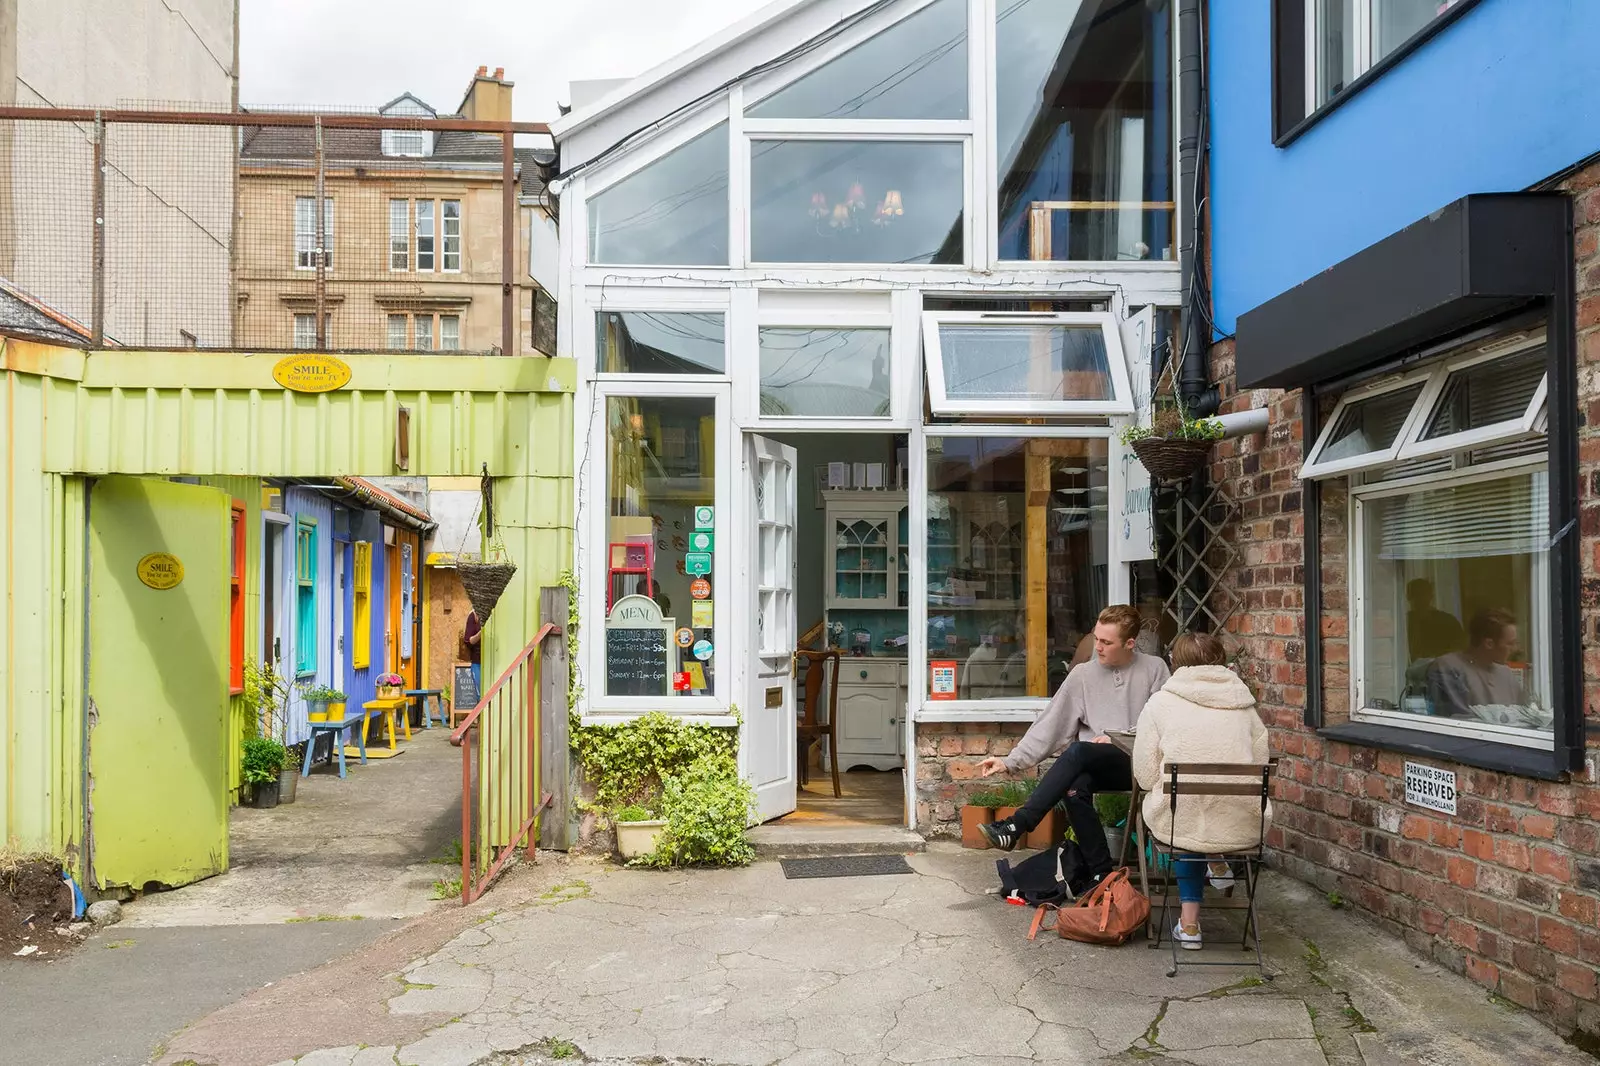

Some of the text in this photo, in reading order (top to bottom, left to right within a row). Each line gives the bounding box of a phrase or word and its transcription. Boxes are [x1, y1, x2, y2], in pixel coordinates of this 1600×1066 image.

[293, 366, 330, 375] SMILE
[150, 563, 172, 572] SMILE
[620, 607, 655, 622] MENU
[1406, 764, 1453, 784] PARKING SPACE
[1406, 776, 1453, 800] RESERVED
[1406, 792, 1415, 801] FOR
[1421, 796, 1455, 812] MULHOLLAND
